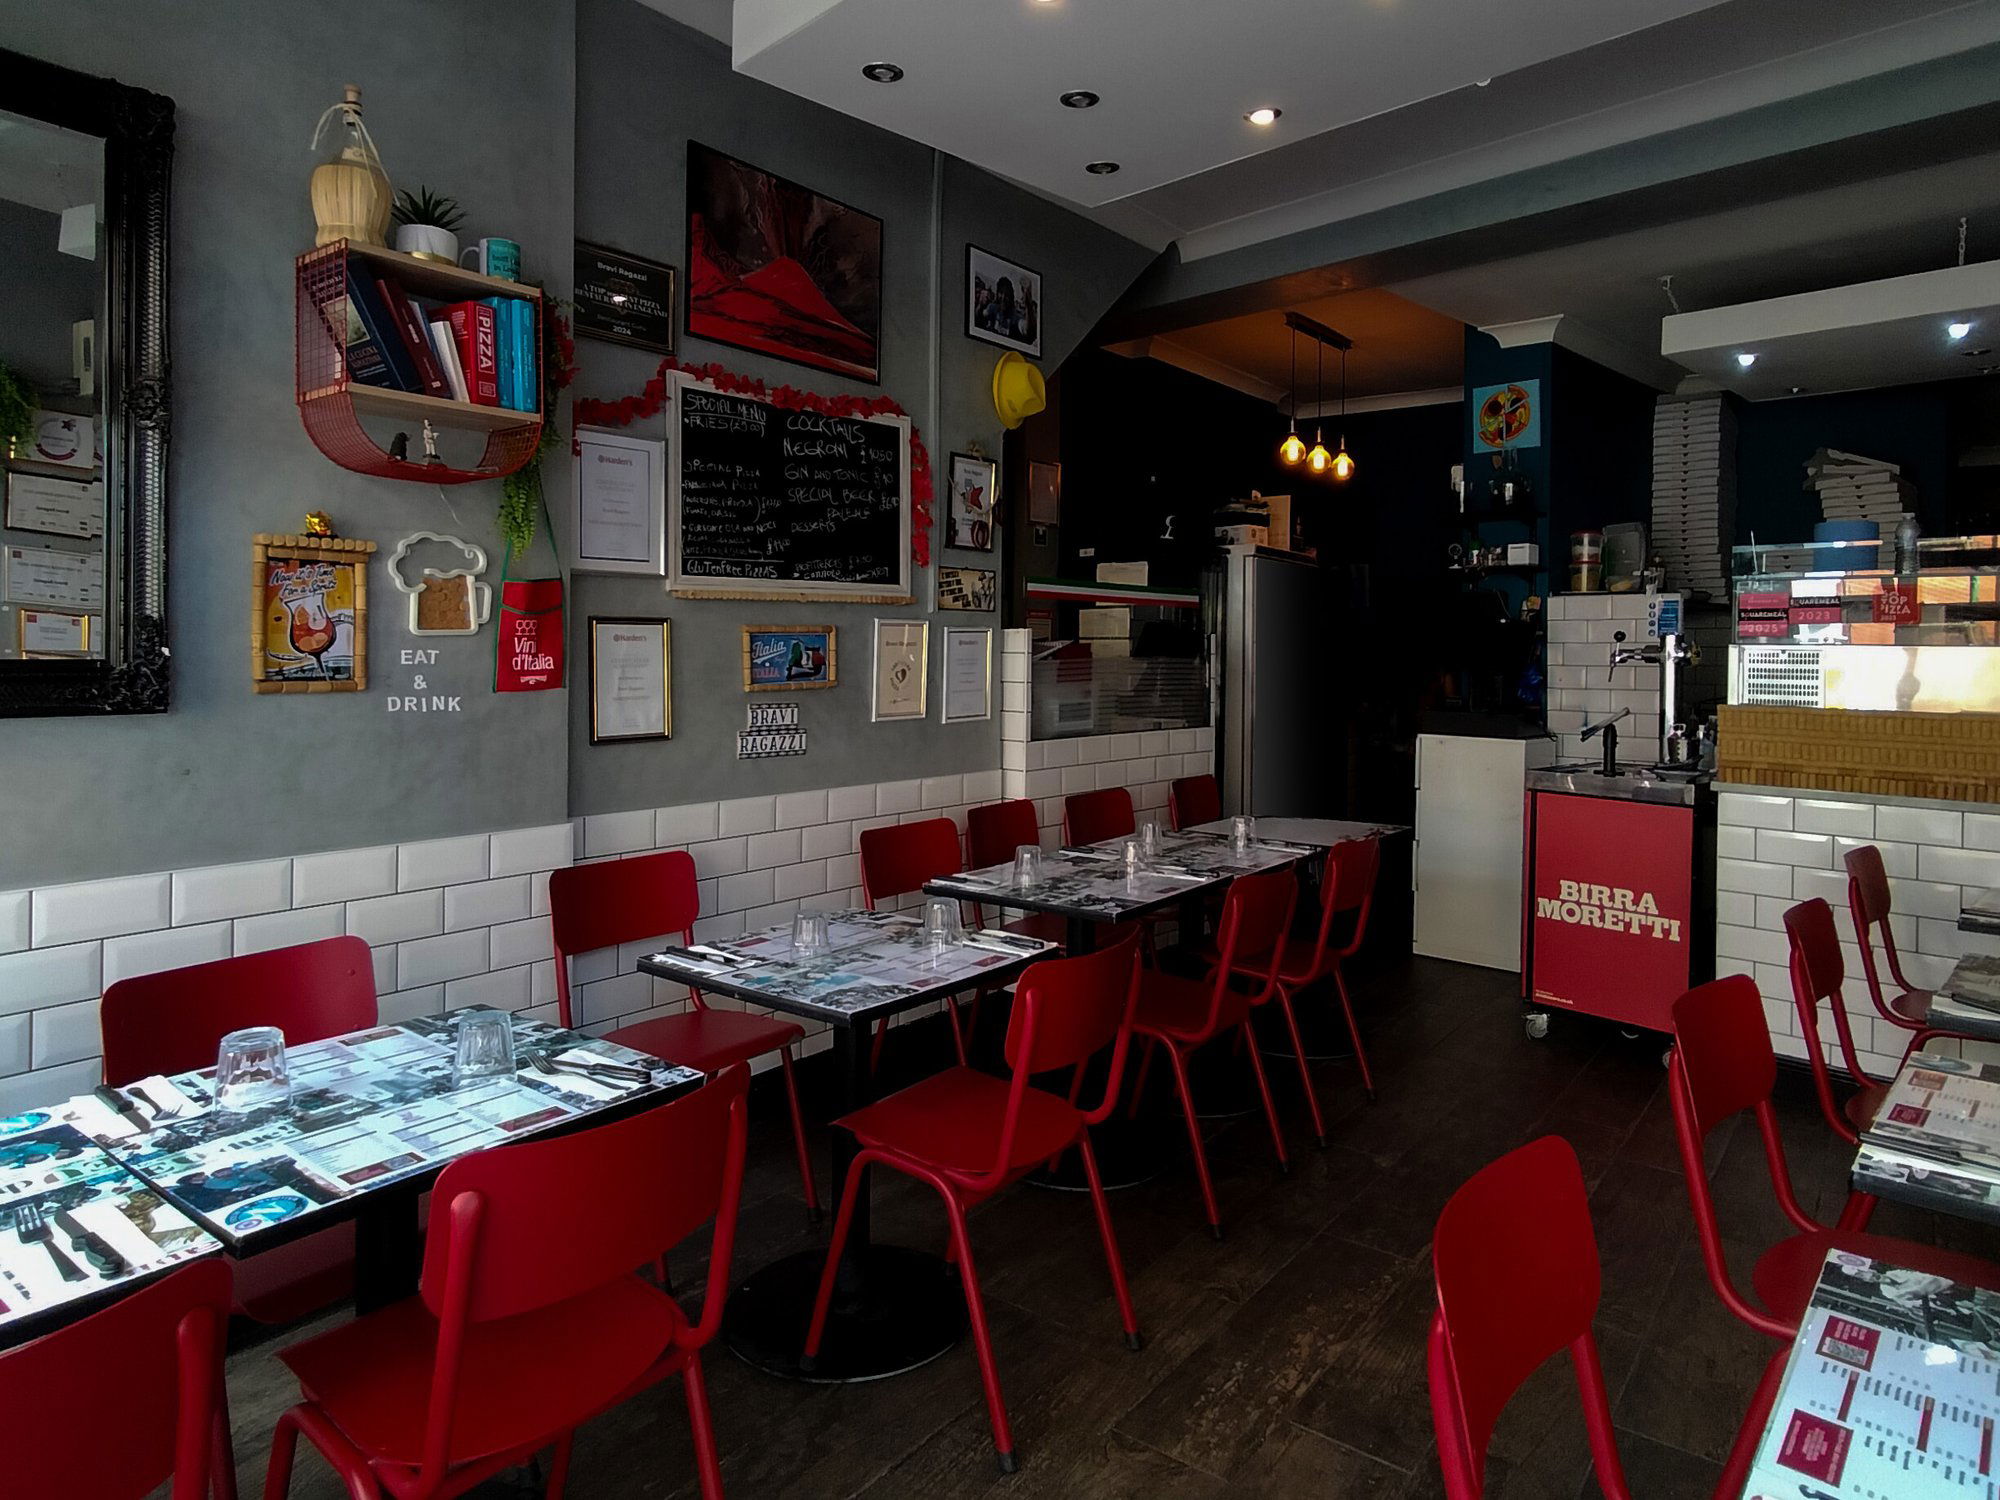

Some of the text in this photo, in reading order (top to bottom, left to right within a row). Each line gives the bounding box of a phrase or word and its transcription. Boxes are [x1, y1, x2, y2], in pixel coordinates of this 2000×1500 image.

[612, 325, 632, 336] 2024
[479, 315, 491, 369] PIZZA
[737, 403, 766, 421] MENU
[690, 416, 728, 429] FRIES
[787, 416, 865, 444] COCKTAILS
[783, 437, 848, 460] NEGRONI
[784, 463, 808, 480] GIN
[814, 470, 831, 480] AND
[833, 468, 869, 483] TONIC
[788, 487, 839, 505] SPECIAL
[842, 487, 876, 504] BEER
[271, 568, 293, 584] Now
[315, 563, 335, 577] Time
[1880, 595, 1908, 605] TOP
[1798, 611, 1831, 620] 2023
[1748, 624, 1778, 632] 2025
[514, 636, 537, 654] Vini
[752, 638, 786, 659] Italia
[400, 649, 440, 665] EAT
[512, 653, 555, 671] d'Italia
[413, 674, 427, 690] &
[387, 695, 461, 712] DRINK
[751, 709, 796, 725] BRAVI
[740, 735, 803, 753] RAGAZZI
[1559, 879, 1659, 915] BIRRA
[1537, 897, 1681, 942] MORETTI
